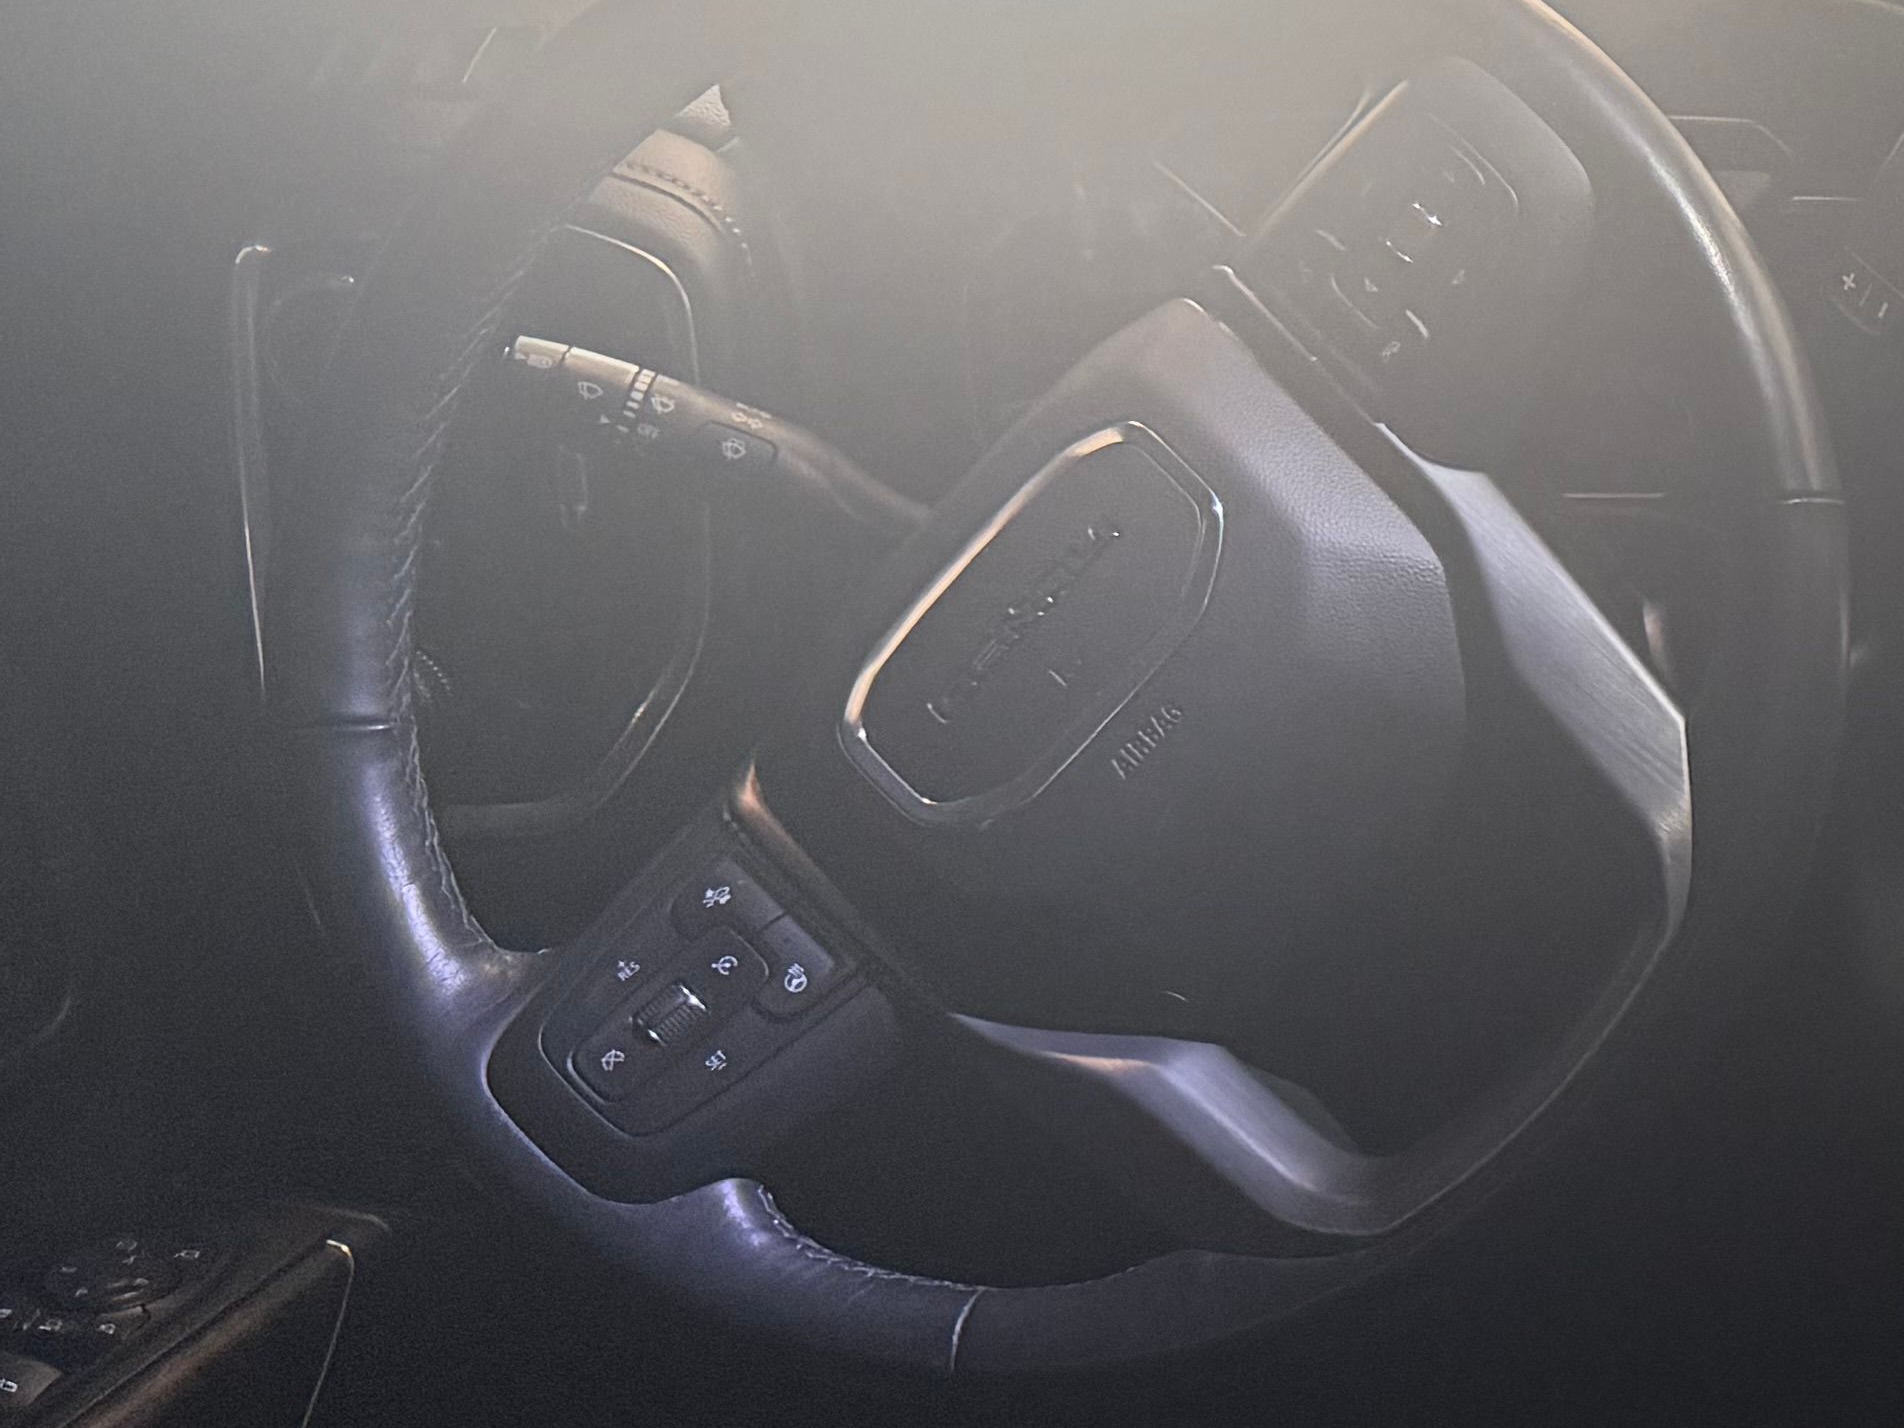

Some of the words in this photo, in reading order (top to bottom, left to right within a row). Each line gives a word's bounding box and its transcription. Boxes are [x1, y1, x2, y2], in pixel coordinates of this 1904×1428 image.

[1109, 703, 1184, 780] AIRBAG
[616, 960, 641, 981] RES
[705, 1049, 727, 1069] SET
